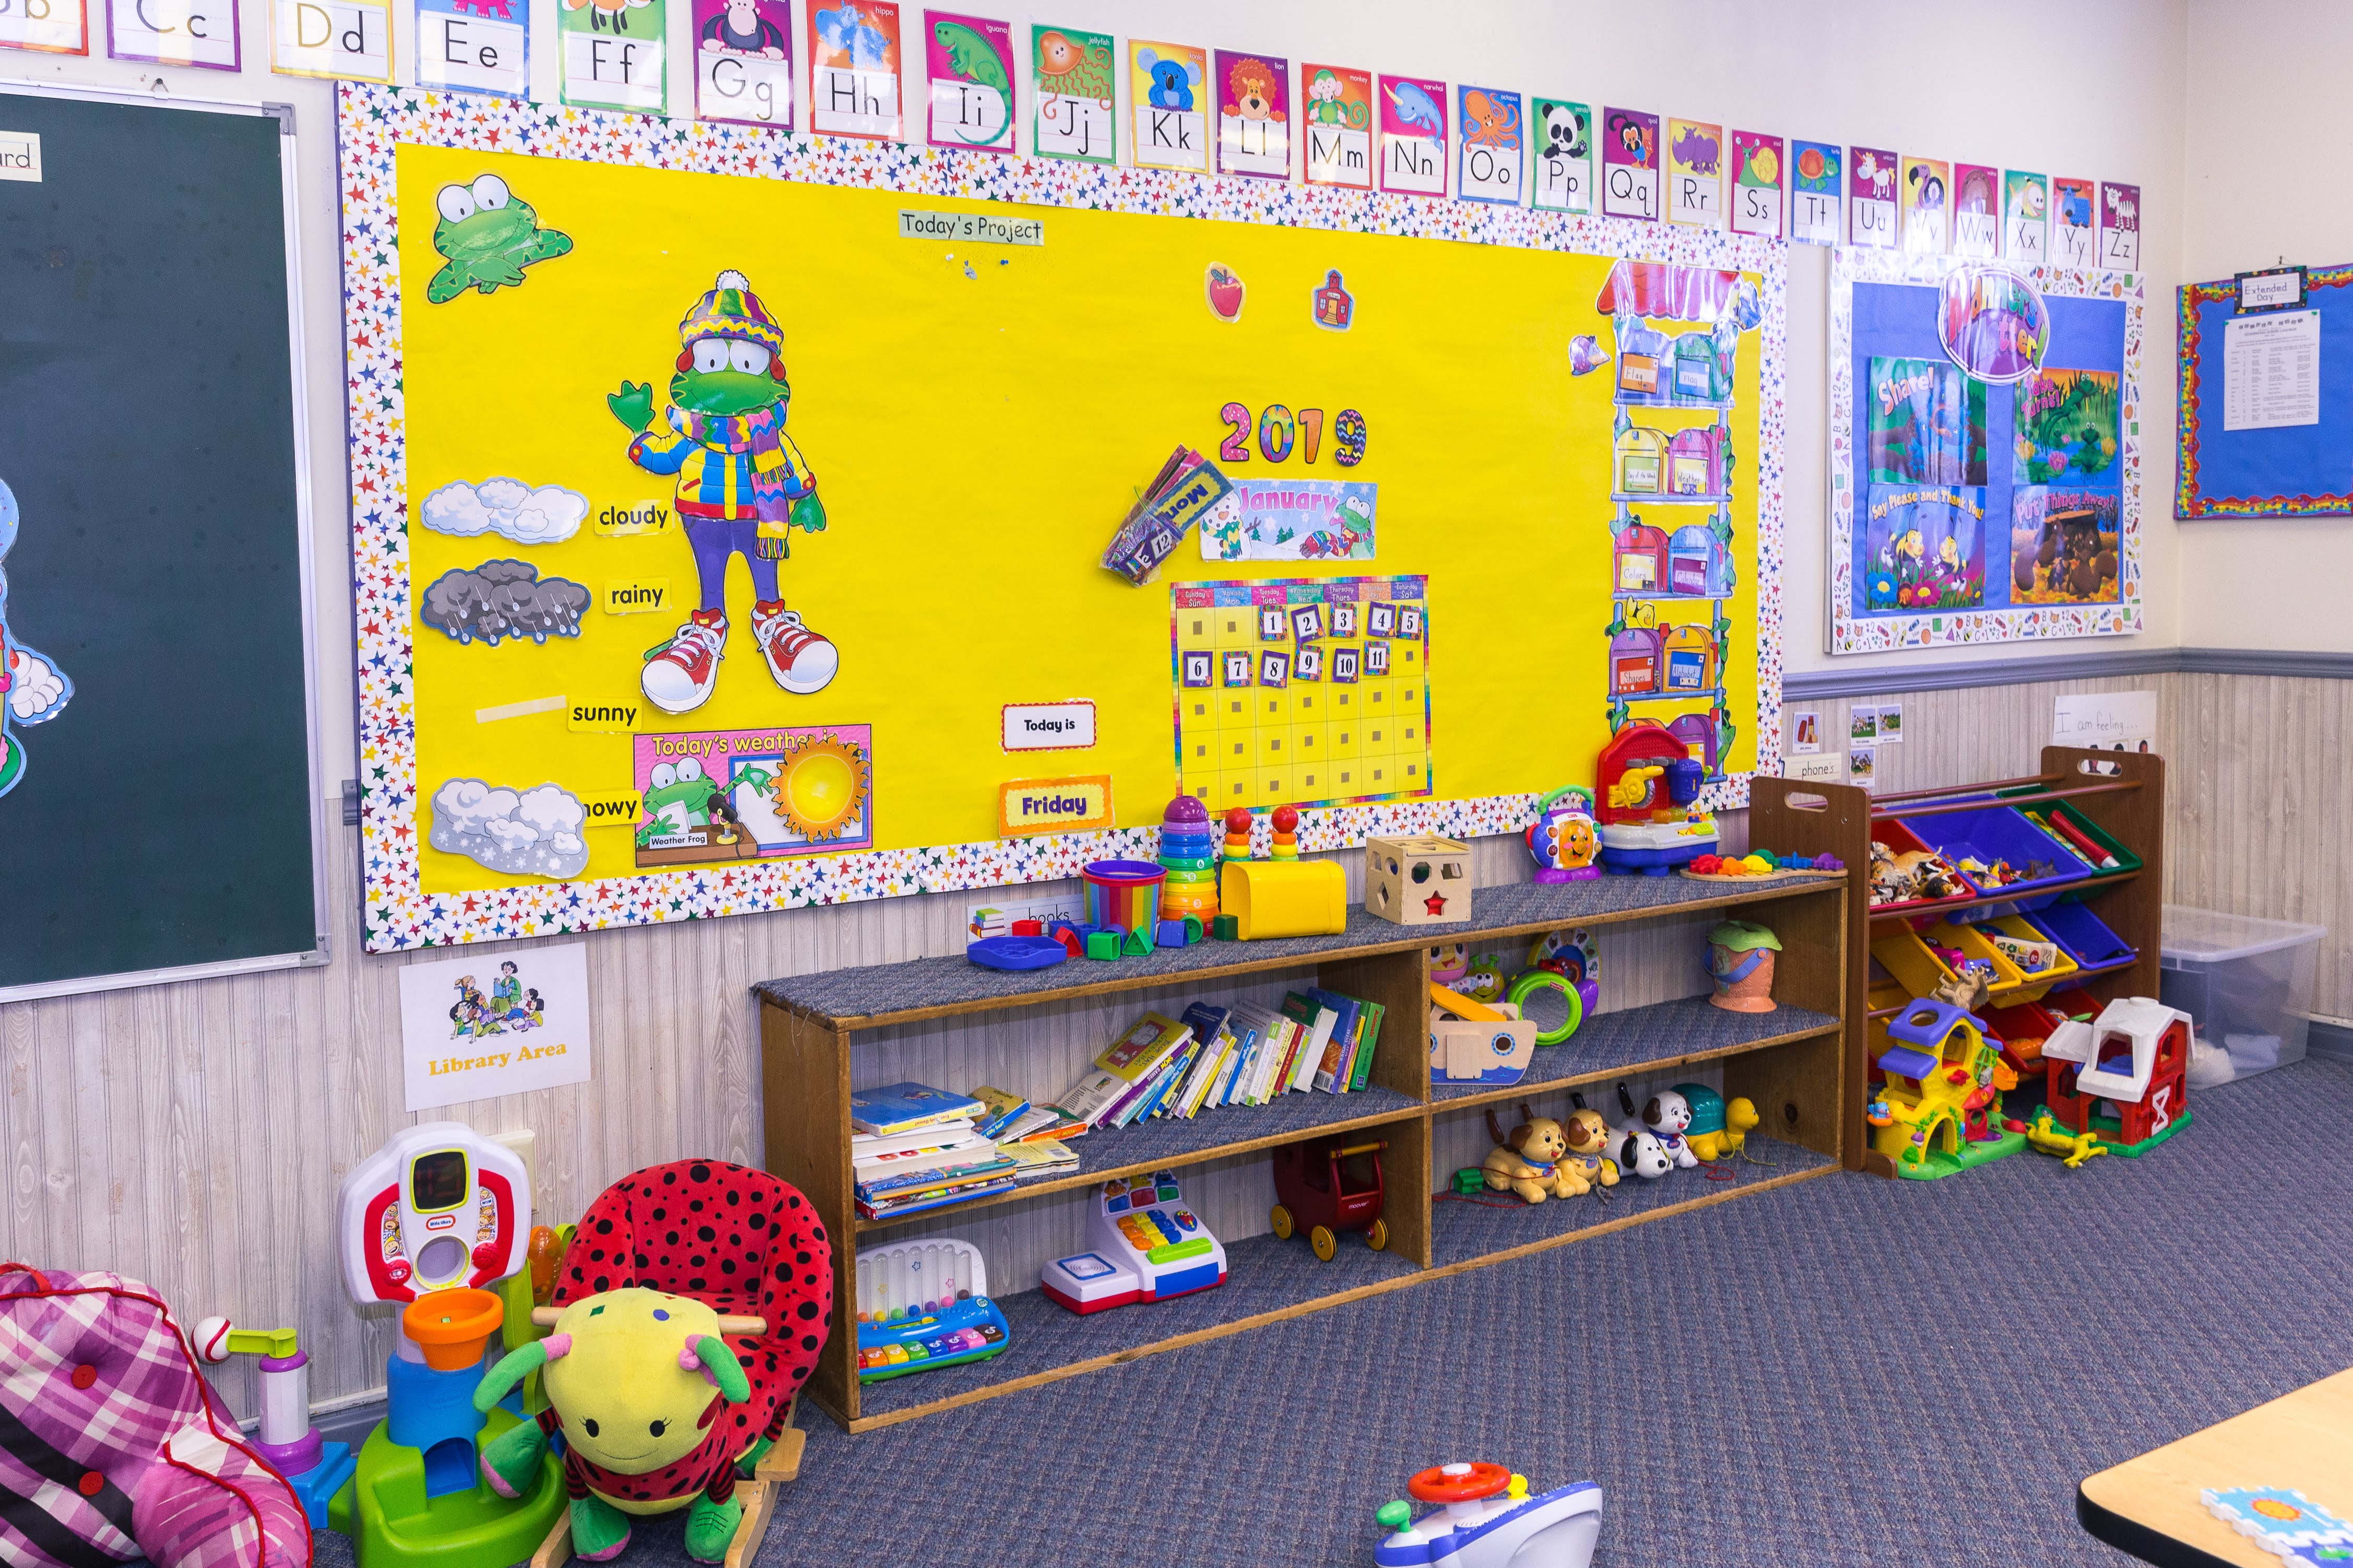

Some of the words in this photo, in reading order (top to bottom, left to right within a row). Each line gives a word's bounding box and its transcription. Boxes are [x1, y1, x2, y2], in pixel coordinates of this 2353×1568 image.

[876, 6, 894, 17] hippo
[986, 23, 1008, 34] iguana
[445, 19, 498, 68] Ee
[1088, 34, 1110, 47] jellyfish
[592, 39, 635, 84] Ff
[1189, 52, 1203, 61] koala
[1274, 62, 1284, 70] lion
[712, 58, 773, 121] Gg
[1350, 74, 1368, 85] monkey
[1423, 83, 1444, 93] narwhal
[831, 73, 879, 116] Hh
[959, 87, 982, 126] Ii
[1059, 101, 1089, 155] Jj
[1152, 111, 1190, 150] Kk
[1313, 130, 1363, 168] Mm
[1394, 140, 1433, 176] Nn
[1550, 160, 1578, 206] Pp
[1611, 169, 1650, 216] Qq
[1683, 179, 1707, 210] Rr
[1747, 189, 1768, 219] Ss
[1807, 197, 1826, 227] Tt
[1862, 202, 1885, 231] Uu
[902, 213, 973, 239] Today's
[978, 217, 1041, 242] Project
[2015, 221, 2036, 249] Xx
[2065, 229, 2085, 265] Yy
[2110, 231, 2130, 258] Zz
[2245, 282, 2287, 295] Extended
[2257, 294, 2274, 303] Day
[1626, 367, 1643, 386] Flag
[1684, 375, 1698, 388] Flag
[2024, 373, 2054, 396] Take
[1878, 367, 1934, 416] Share!
[2021, 392, 2061, 423] Turns!
[1220, 402, 1366, 467] 2019
[1677, 471, 1700, 484] Weather
[1239, 486, 1340, 523] January
[1872, 502, 1887, 520] Say
[1888, 491, 1918, 512] Please
[1921, 490, 1937, 503] and
[1941, 492, 1966, 511] Thank
[1967, 500, 1984, 521] You!
[2016, 498, 2041, 522] Put
[2043, 492, 2081, 513] Things
[2081, 490, 2114, 509] Away!
[599, 506, 668, 528] cloudy
[1154, 534, 1171, 555] 12
[1624, 568, 1647, 580] Colors
[612, 585, 663, 607] rainy
[1185, 590, 1205, 600] Sunday
[1222, 590, 1244, 599] Monday
[1259, 588, 1280, 597] Tuesday
[1329, 586, 1354, 595] Thursday
[1396, 584, 1418, 592] Saturday
[1188, 599, 1203, 607] Sun.
[1262, 596, 1279, 605] Tues.
[1332, 593, 1352, 602] Thurs.
[1270, 615, 1275, 631] 1
[1303, 616, 1312, 632] 2
[1340, 612, 1347, 628] 3
[1378, 612, 1386, 628] 4
[1406, 615, 1413, 630] 5
[1195, 661, 1202, 677] 6
[1234, 661, 1241, 677] 7
[1270, 661, 1279, 678] 8
[1305, 654, 1313, 670] 9
[1340, 658, 1353, 674] 10
[1372, 650, 1382, 666] 11
[1624, 672, 1646, 687] Shapes
[573, 705, 637, 726] sunny
[1024, 719, 1062, 733] Today
[1065, 719, 1075, 730] is
[2055, 712, 2072, 734] I
[2077, 720, 2093, 730] am
[652, 735, 728, 759] Today's
[1801, 762, 1834, 778] phone's
[1022, 795, 1086, 816] Friday
[651, 836, 685, 846] Weather
[688, 835, 706, 846] Frog
[1028, 904, 1070, 924] books
[1369, 1010, 1380, 1038] Animals
[1247, 1034, 1255, 1047] Hello,
[429, 1052, 512, 1077] Library
[517, 1043, 567, 1062] Area
[1158, 1055, 1174, 1070] SNOW
[1146, 1066, 1161, 1082] BABIES
